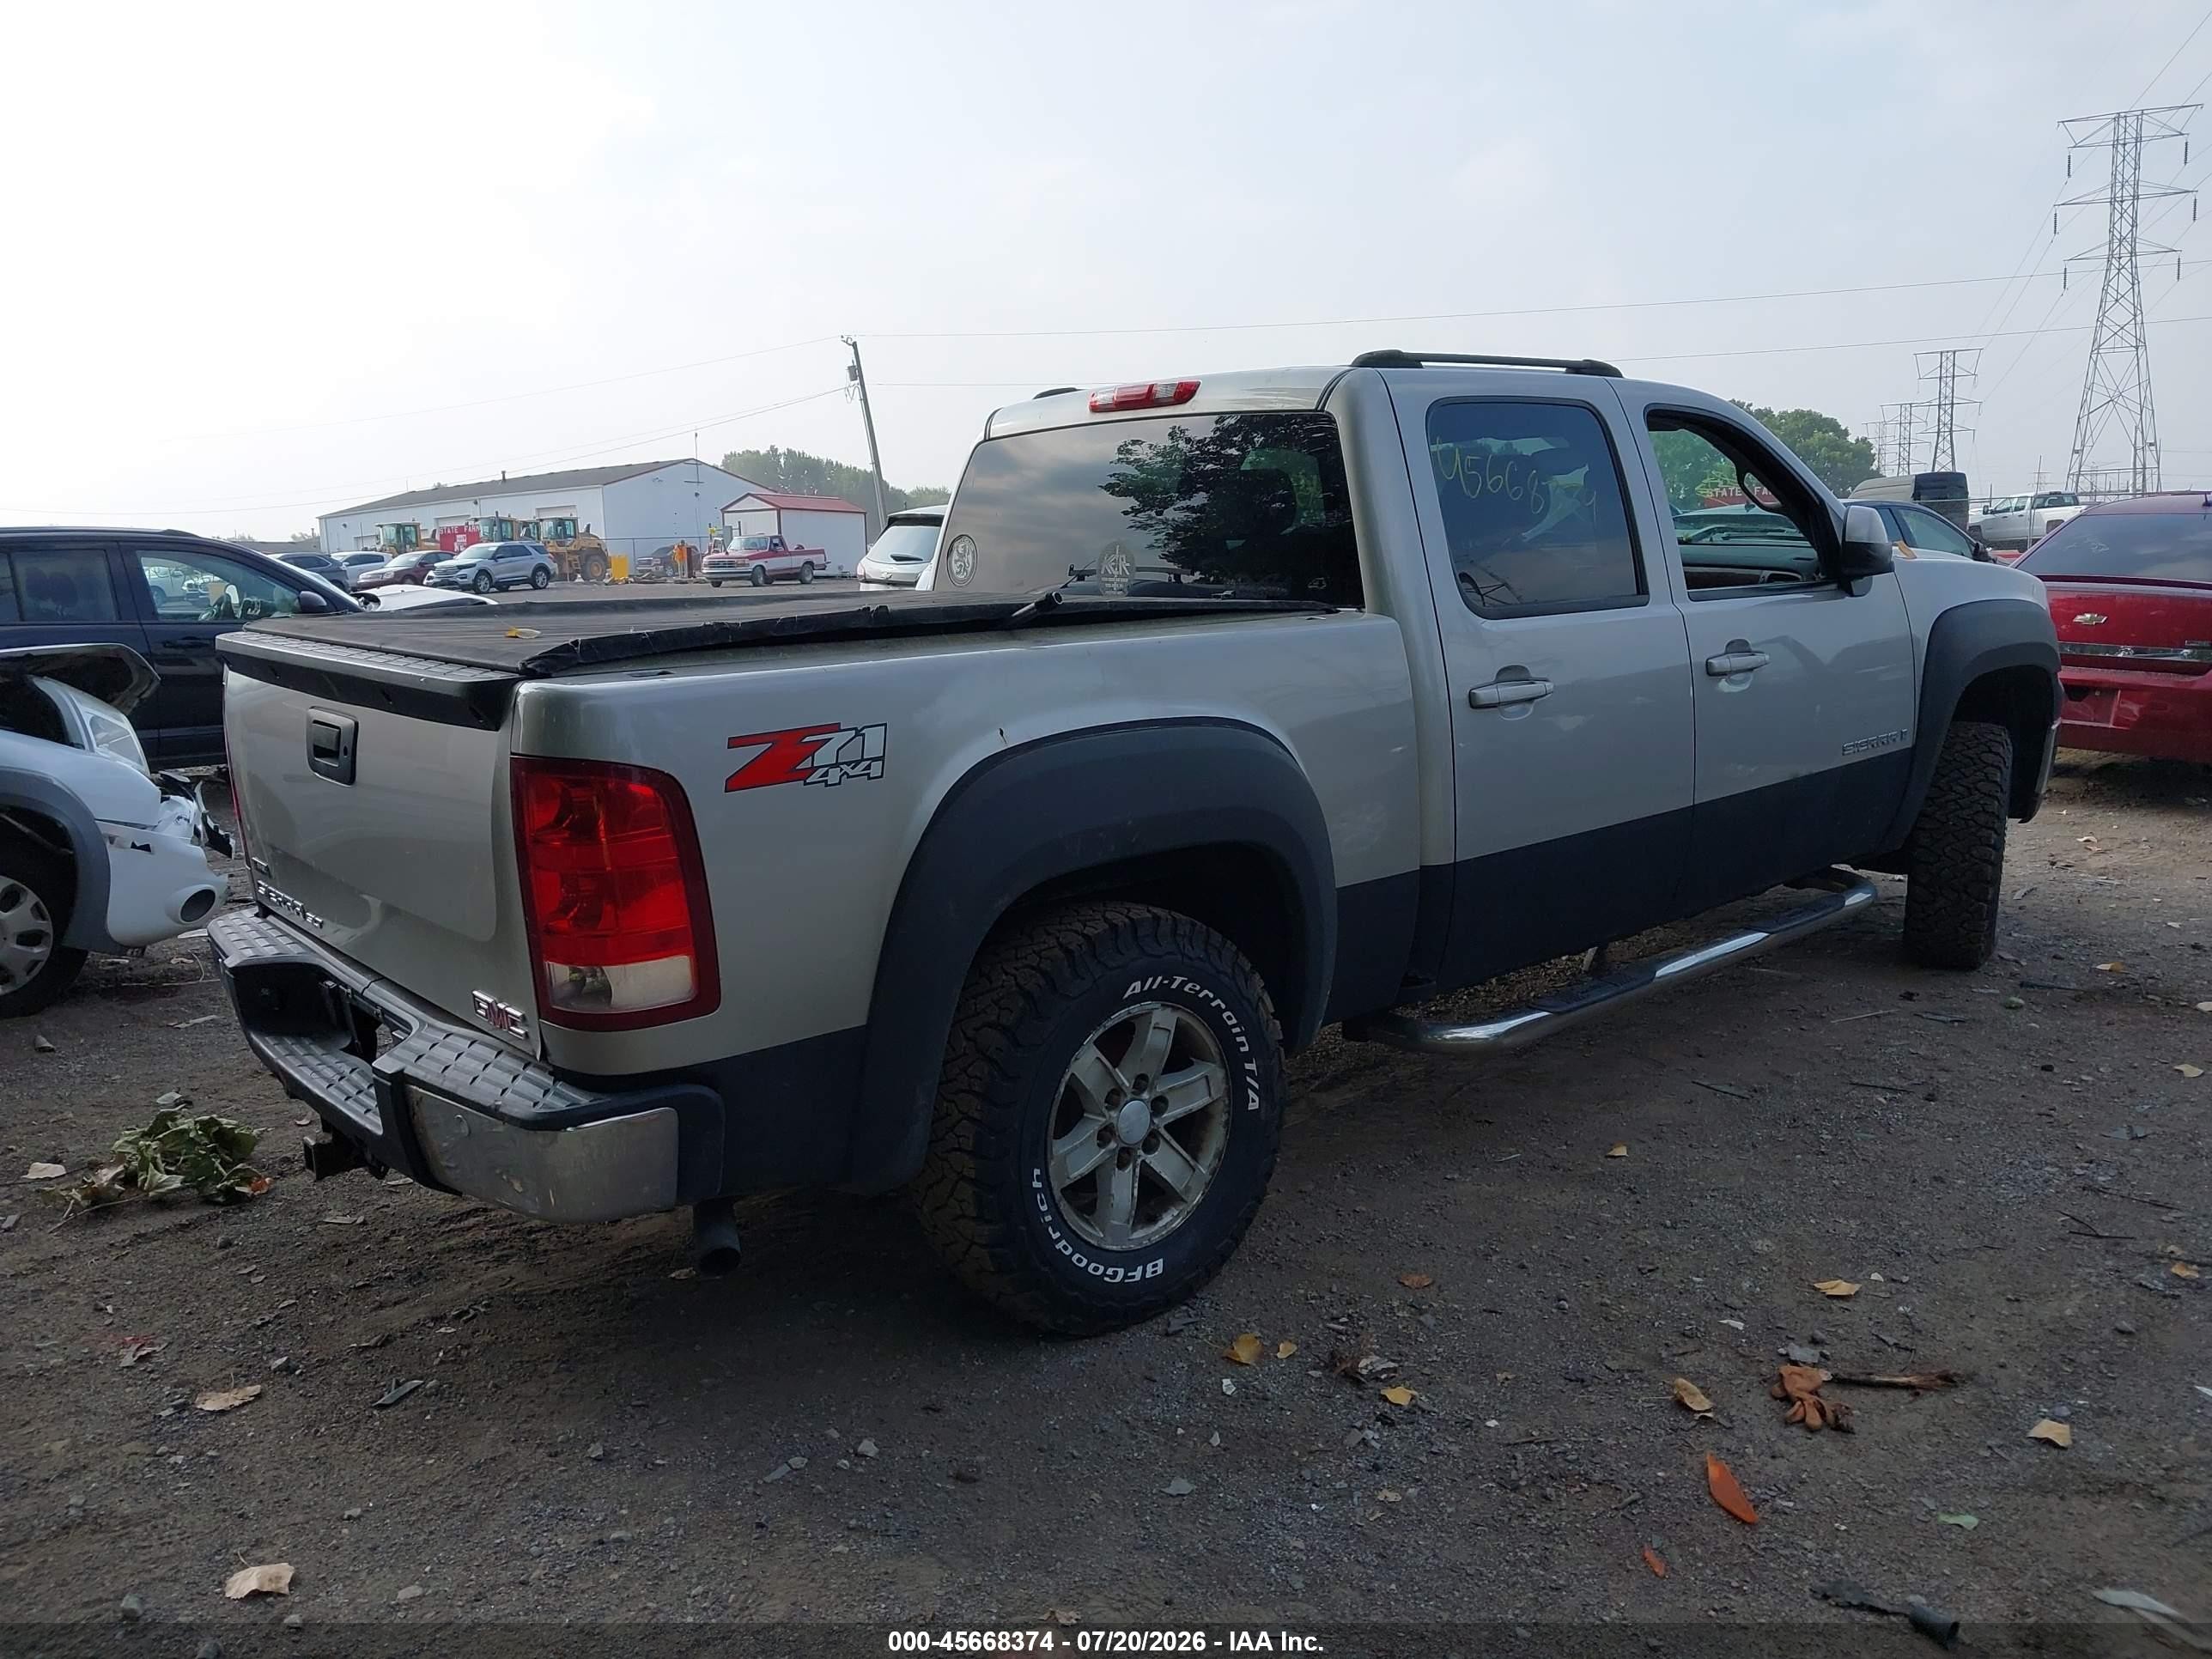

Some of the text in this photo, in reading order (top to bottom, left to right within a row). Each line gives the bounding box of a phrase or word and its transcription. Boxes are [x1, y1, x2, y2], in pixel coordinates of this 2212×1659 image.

[439, 526, 459, 535] STATE
[725, 722, 887, 793] Z71
[471, 989, 528, 1040] GMC
[1122, 975, 1260, 1111] All-Terrain T/A
[1032, 1168, 1164, 1283] BFGoodrich
